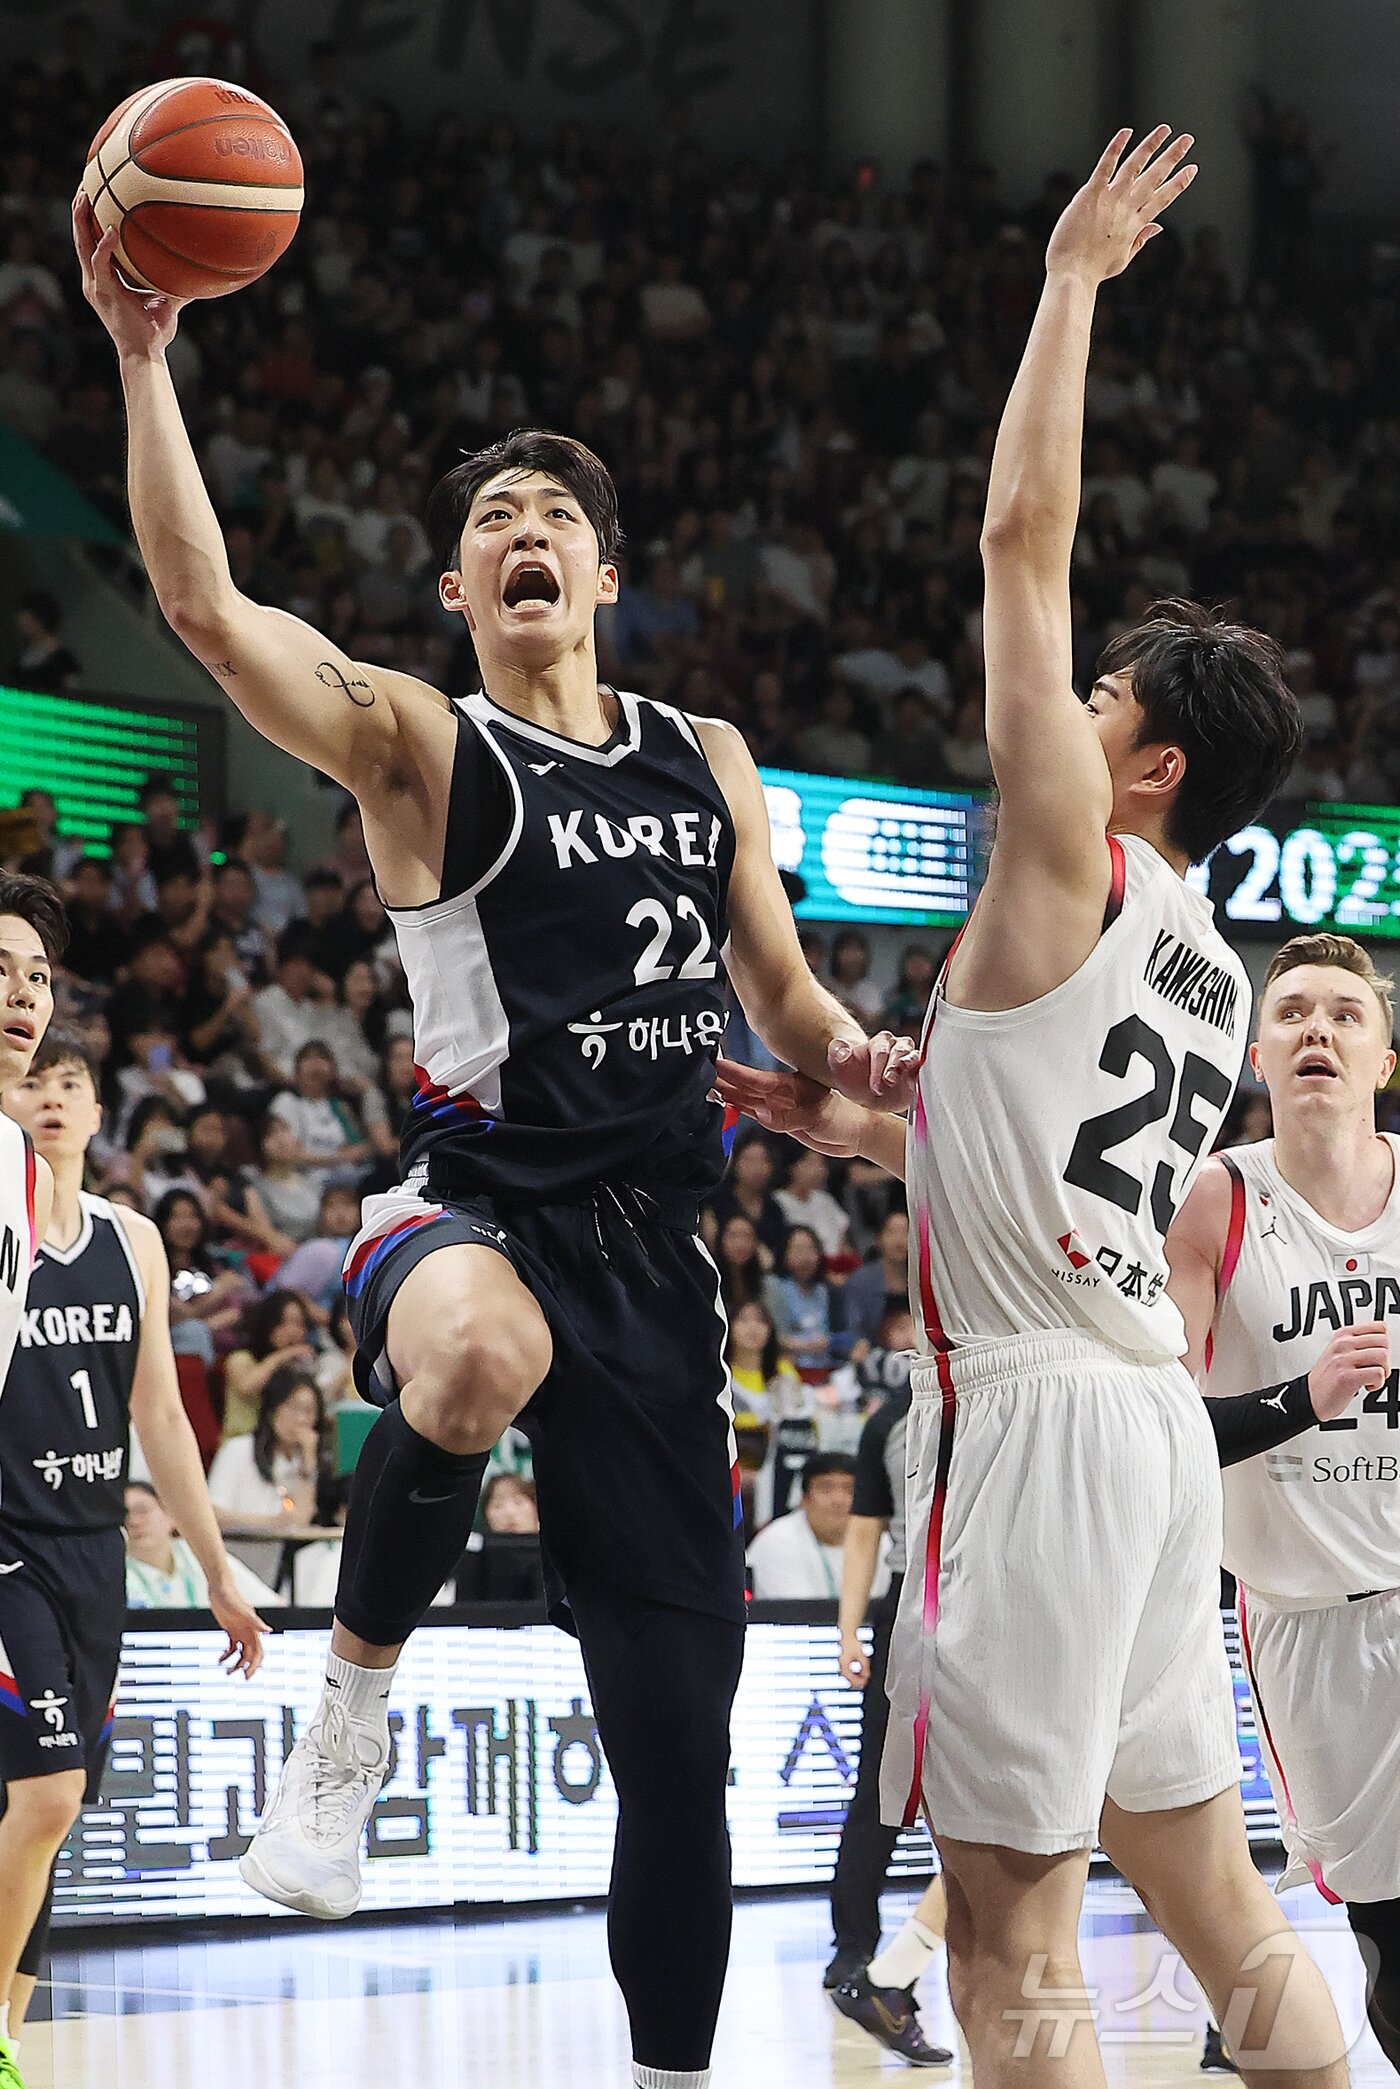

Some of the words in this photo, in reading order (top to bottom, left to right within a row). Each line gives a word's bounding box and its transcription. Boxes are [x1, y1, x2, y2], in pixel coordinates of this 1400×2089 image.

[1225, 825, 1400, 926] 202
[624, 894, 717, 987] 22
[628, 1009, 730, 1061] 하나은
[1062, 1013, 1233, 1238] 25
[19, 1303, 133, 1348] KOREA
[69, 1368, 99, 1429] 1
[1318, 1368, 1400, 1432] 4
[1312, 1455, 1400, 1484] SoftB
